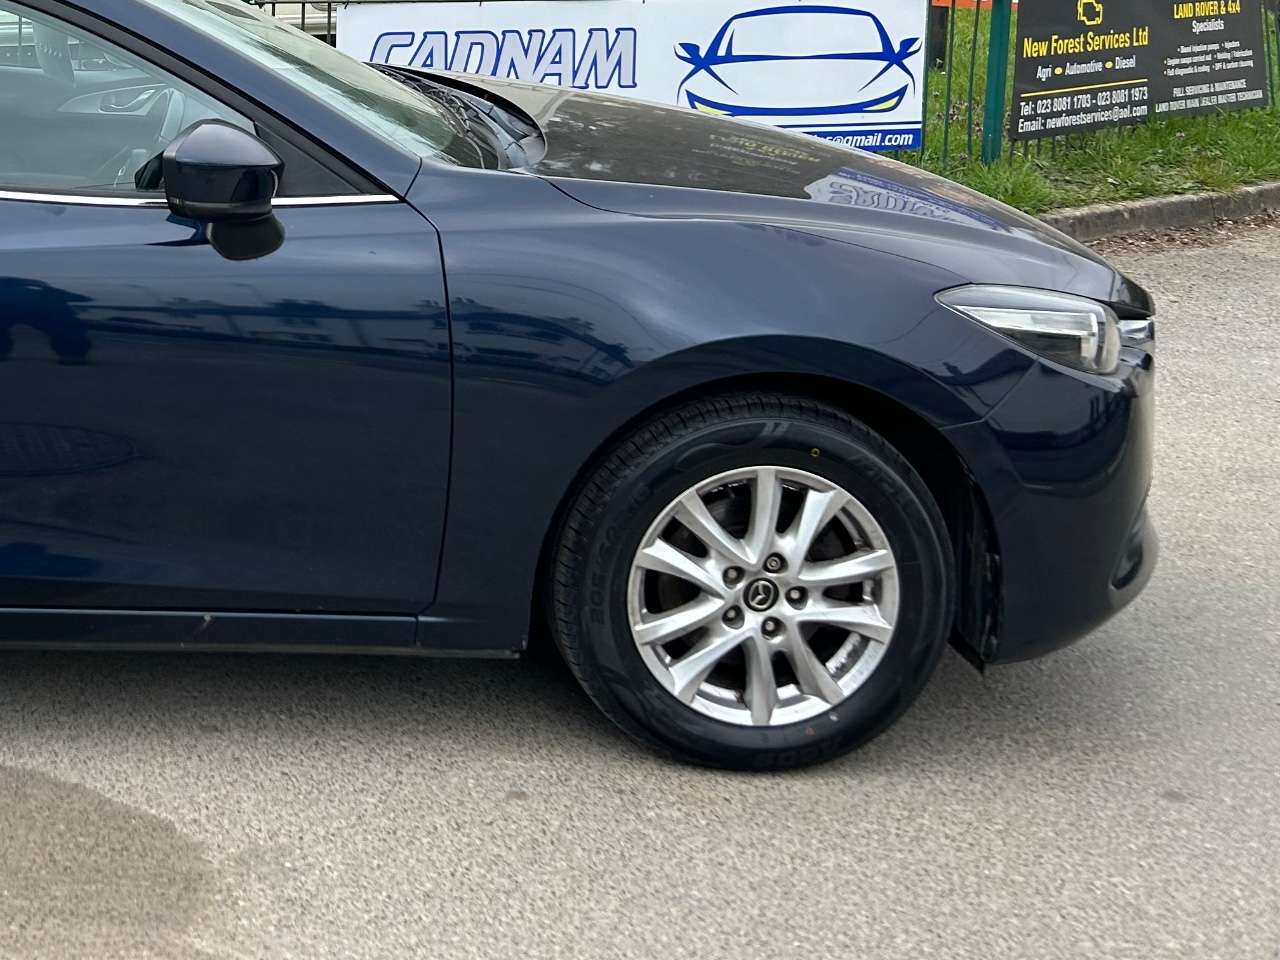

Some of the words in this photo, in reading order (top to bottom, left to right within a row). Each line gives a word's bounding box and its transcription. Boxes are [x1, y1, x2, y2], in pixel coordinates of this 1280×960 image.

[1173, 2, 1194, 19] LAND
[1195, 0, 1219, 17] ROVER
[1220, 0, 1226, 14] &
[1227, 0, 1240, 14] 4x4
[1192, 19, 1225, 35] Specialists
[1023, 37, 1049, 58] New
[1051, 34, 1085, 55] Forest
[1086, 29, 1130, 52] Services
[1133, 26, 1149, 47] Ltd
[370, 27, 638, 89] CADNAM
[1036, 65, 1052, 81] Agri
[1064, 59, 1104, 76] Automotive
[1115, 54, 1136, 70] Diesel
[1019, 101, 1035, 116] Tel:
[1036, 98, 1052, 114] 023
[1053, 96, 1071, 112] 8081
[1074, 93, 1092, 109] 1703
[1097, 91, 1111, 106] 023
[1112, 88, 1129, 104] 8081
[1131, 86, 1148, 102] 1973
[1018, 116, 1045, 132] Email:
[1046, 105, 1148, 129] newforestservices@aol.com
